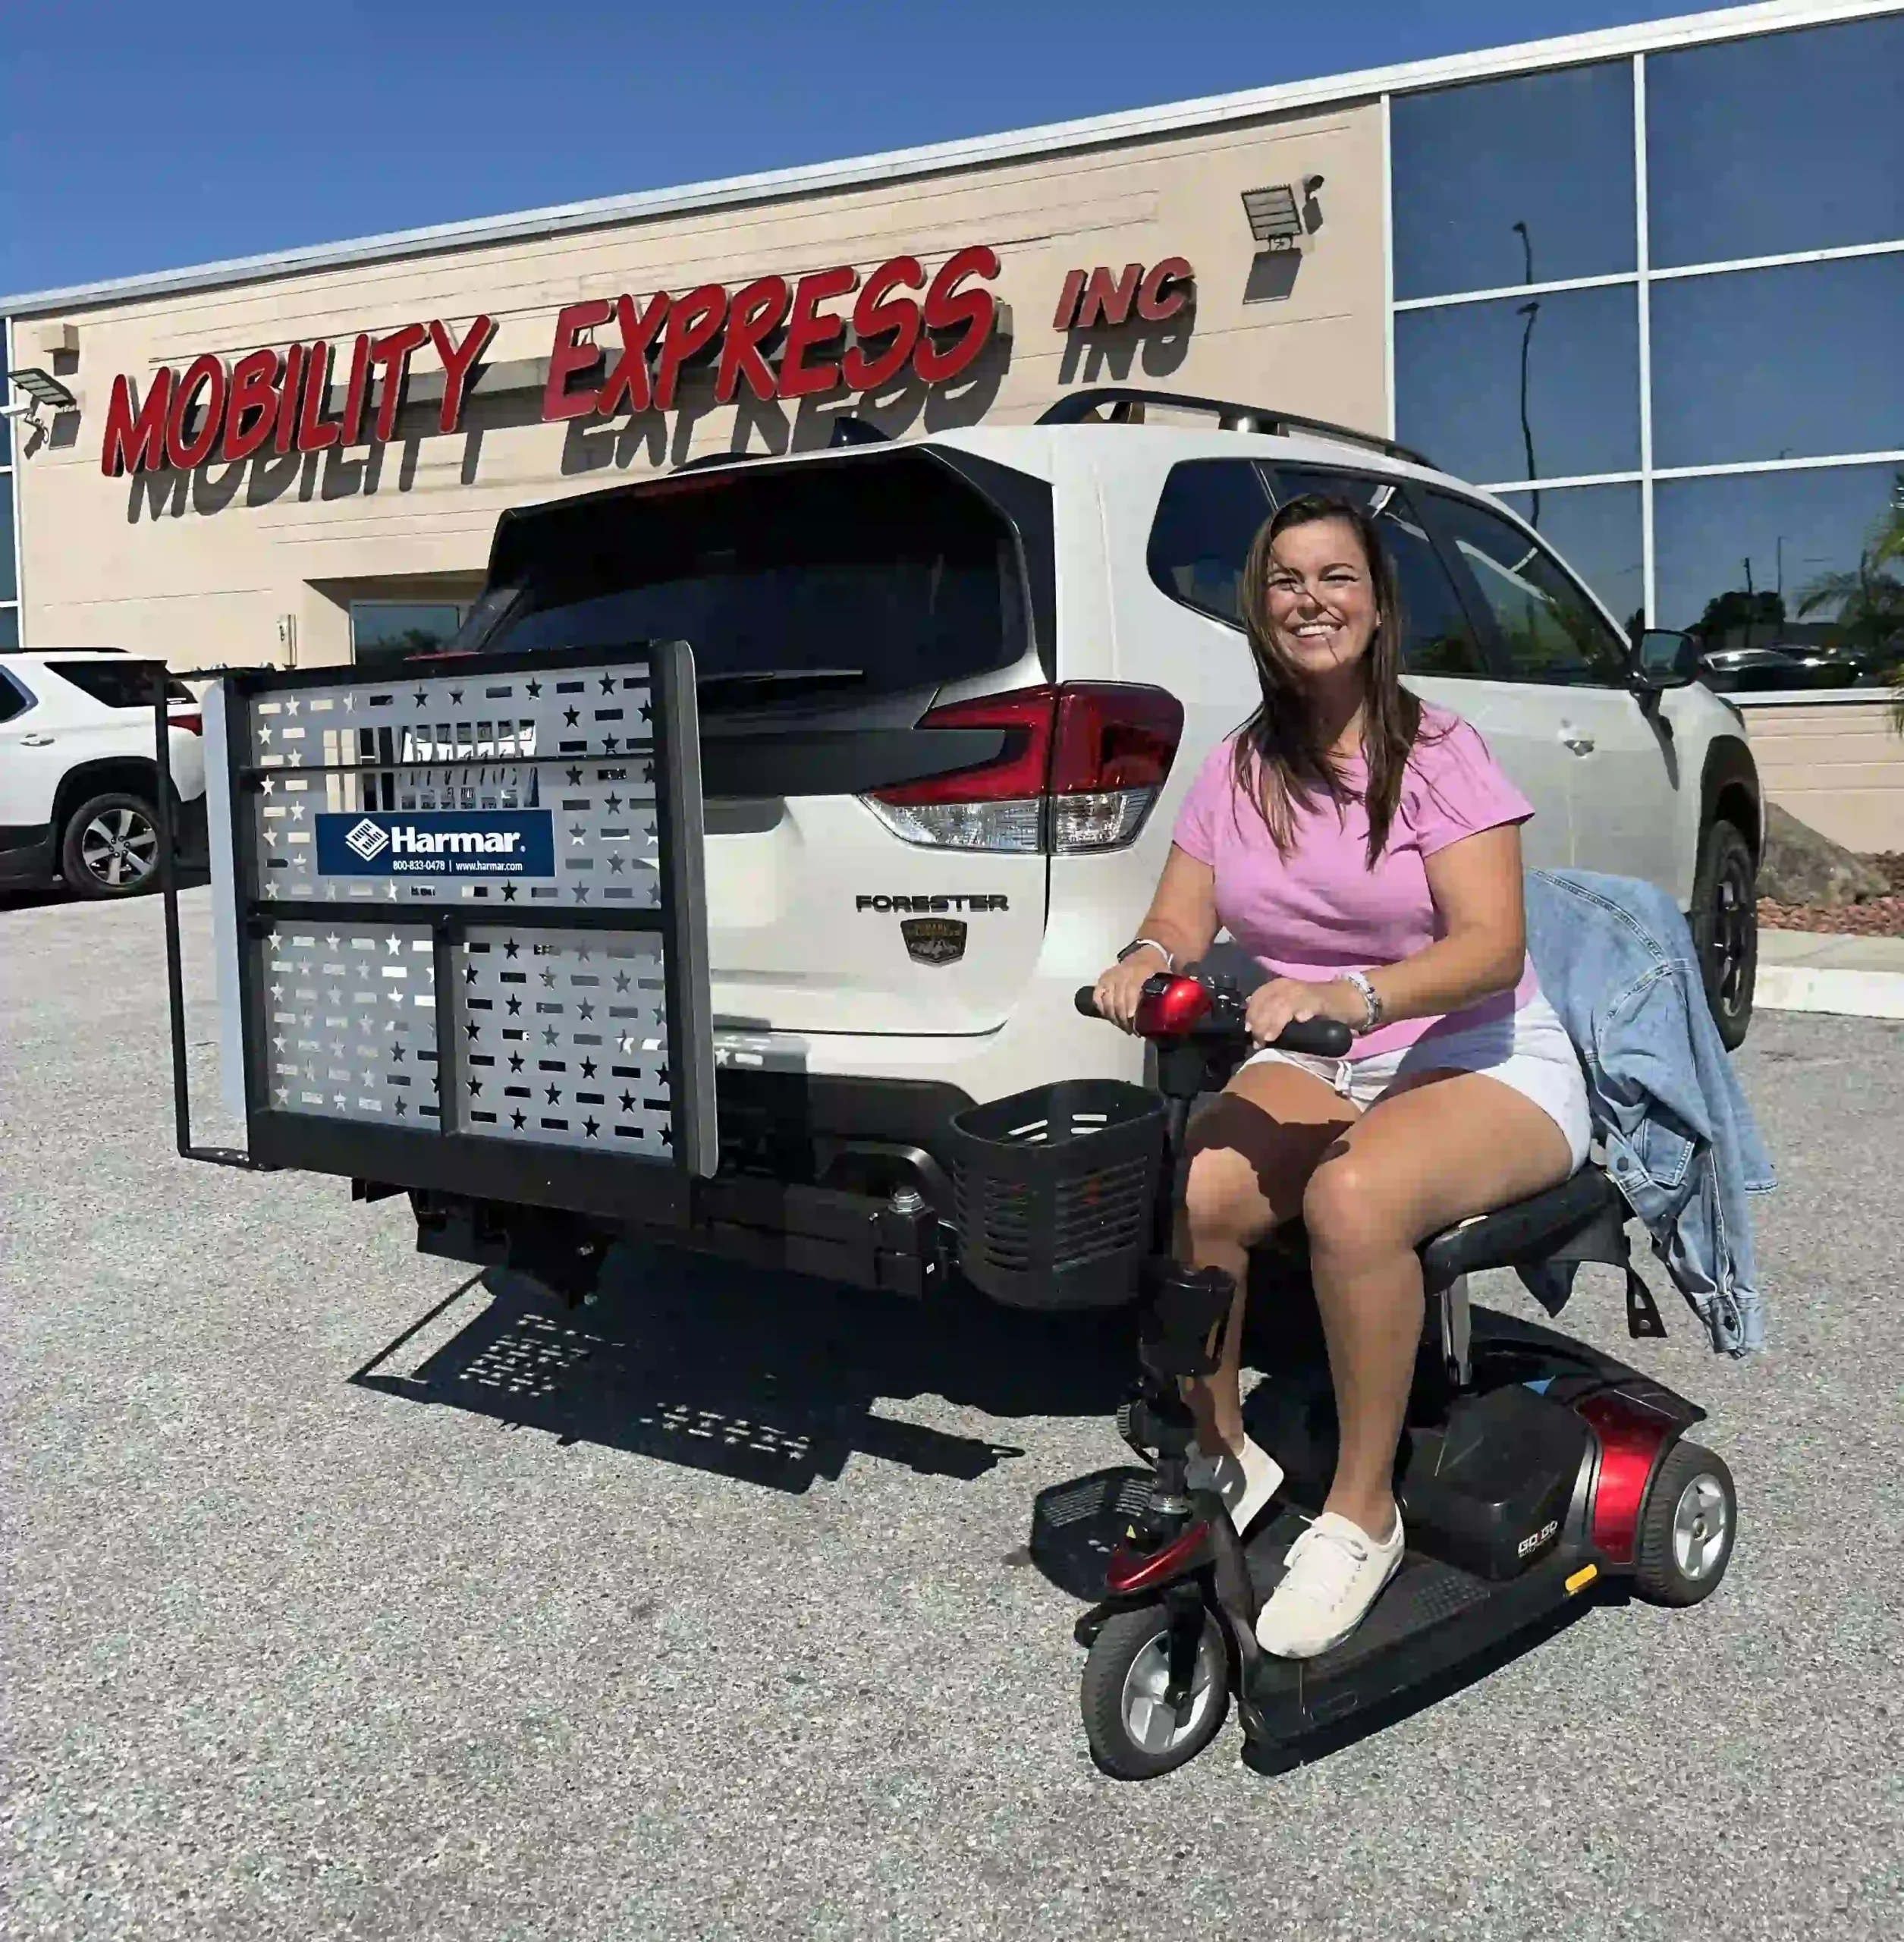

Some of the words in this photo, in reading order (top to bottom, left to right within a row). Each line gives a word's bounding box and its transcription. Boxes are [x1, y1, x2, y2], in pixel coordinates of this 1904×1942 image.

[102, 315, 495, 477] MOBILITY
[542, 245, 998, 422] EXPRESS
[1052, 256, 1192, 332] INC
[393, 859, 445, 871] 800-833-0478
[456, 860, 523, 872] www.harmar.com
[856, 894, 1010, 913] FORESTER
